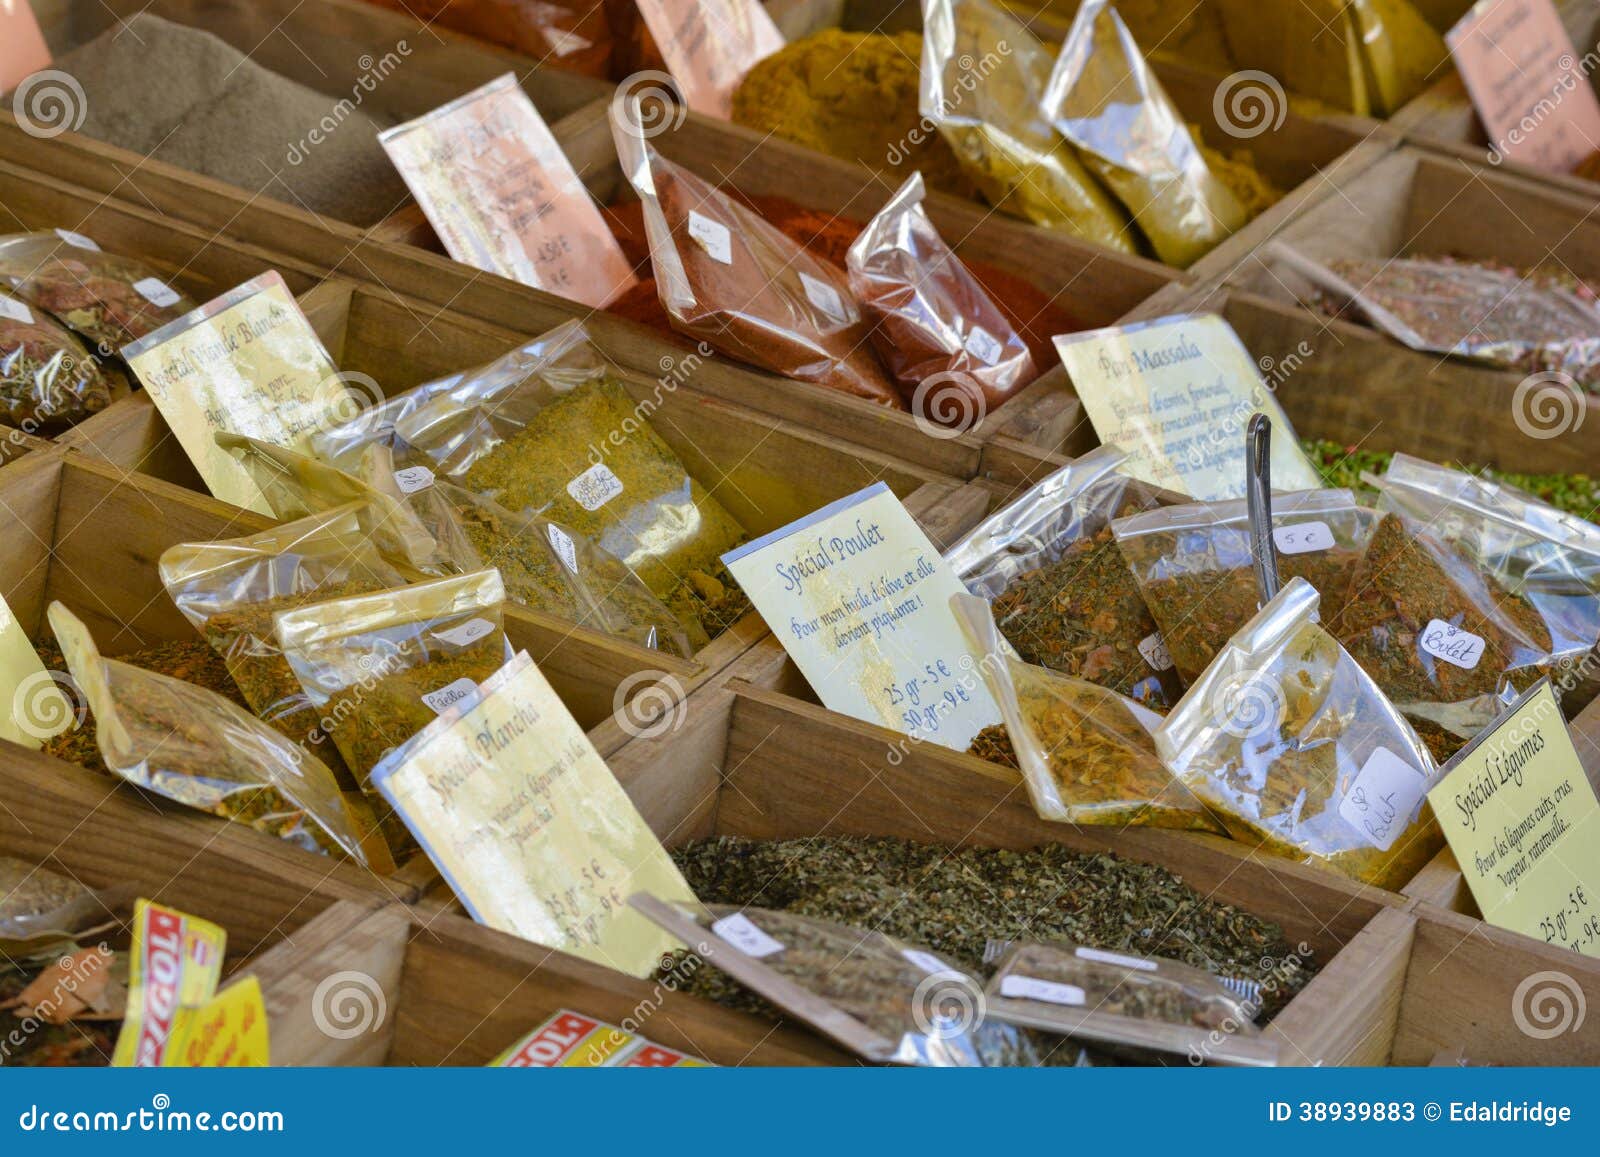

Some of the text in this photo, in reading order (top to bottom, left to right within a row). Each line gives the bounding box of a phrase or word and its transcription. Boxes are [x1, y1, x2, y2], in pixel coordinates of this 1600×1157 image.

[1132, 334, 1203, 373] Massala
[776, 519, 885, 596] Spécial Poulet
[791, 610, 820, 640] Pour
[820, 606, 845, 625] mon
[844, 587, 871, 617] huile
[903, 569, 918, 589] et
[916, 555, 936, 581] elle
[834, 619, 871, 649] devient
[870, 600, 916, 640] piquante
[883, 684, 905, 706] 25
[905, 678, 922, 706] gr
[926, 664, 939, 684] 5
[936, 658, 951, 678] €
[902, 710, 922, 731] 50
[923, 703, 941, 732] gr
[943, 690, 958, 712] 9
[954, 683, 971, 703] €
[475, 695, 542, 760] Plancha
[1455, 729, 1545, 832] Spécial Légumes
[1474, 778, 1574, 878] Pour les légumes cuits, crus,
[1539, 916, 1556, 944] 25
[1554, 907, 1568, 941] gr
[1568, 892, 1580, 914] 5
[1576, 885, 1588, 905] €
[1583, 922, 1594, 945] 9
